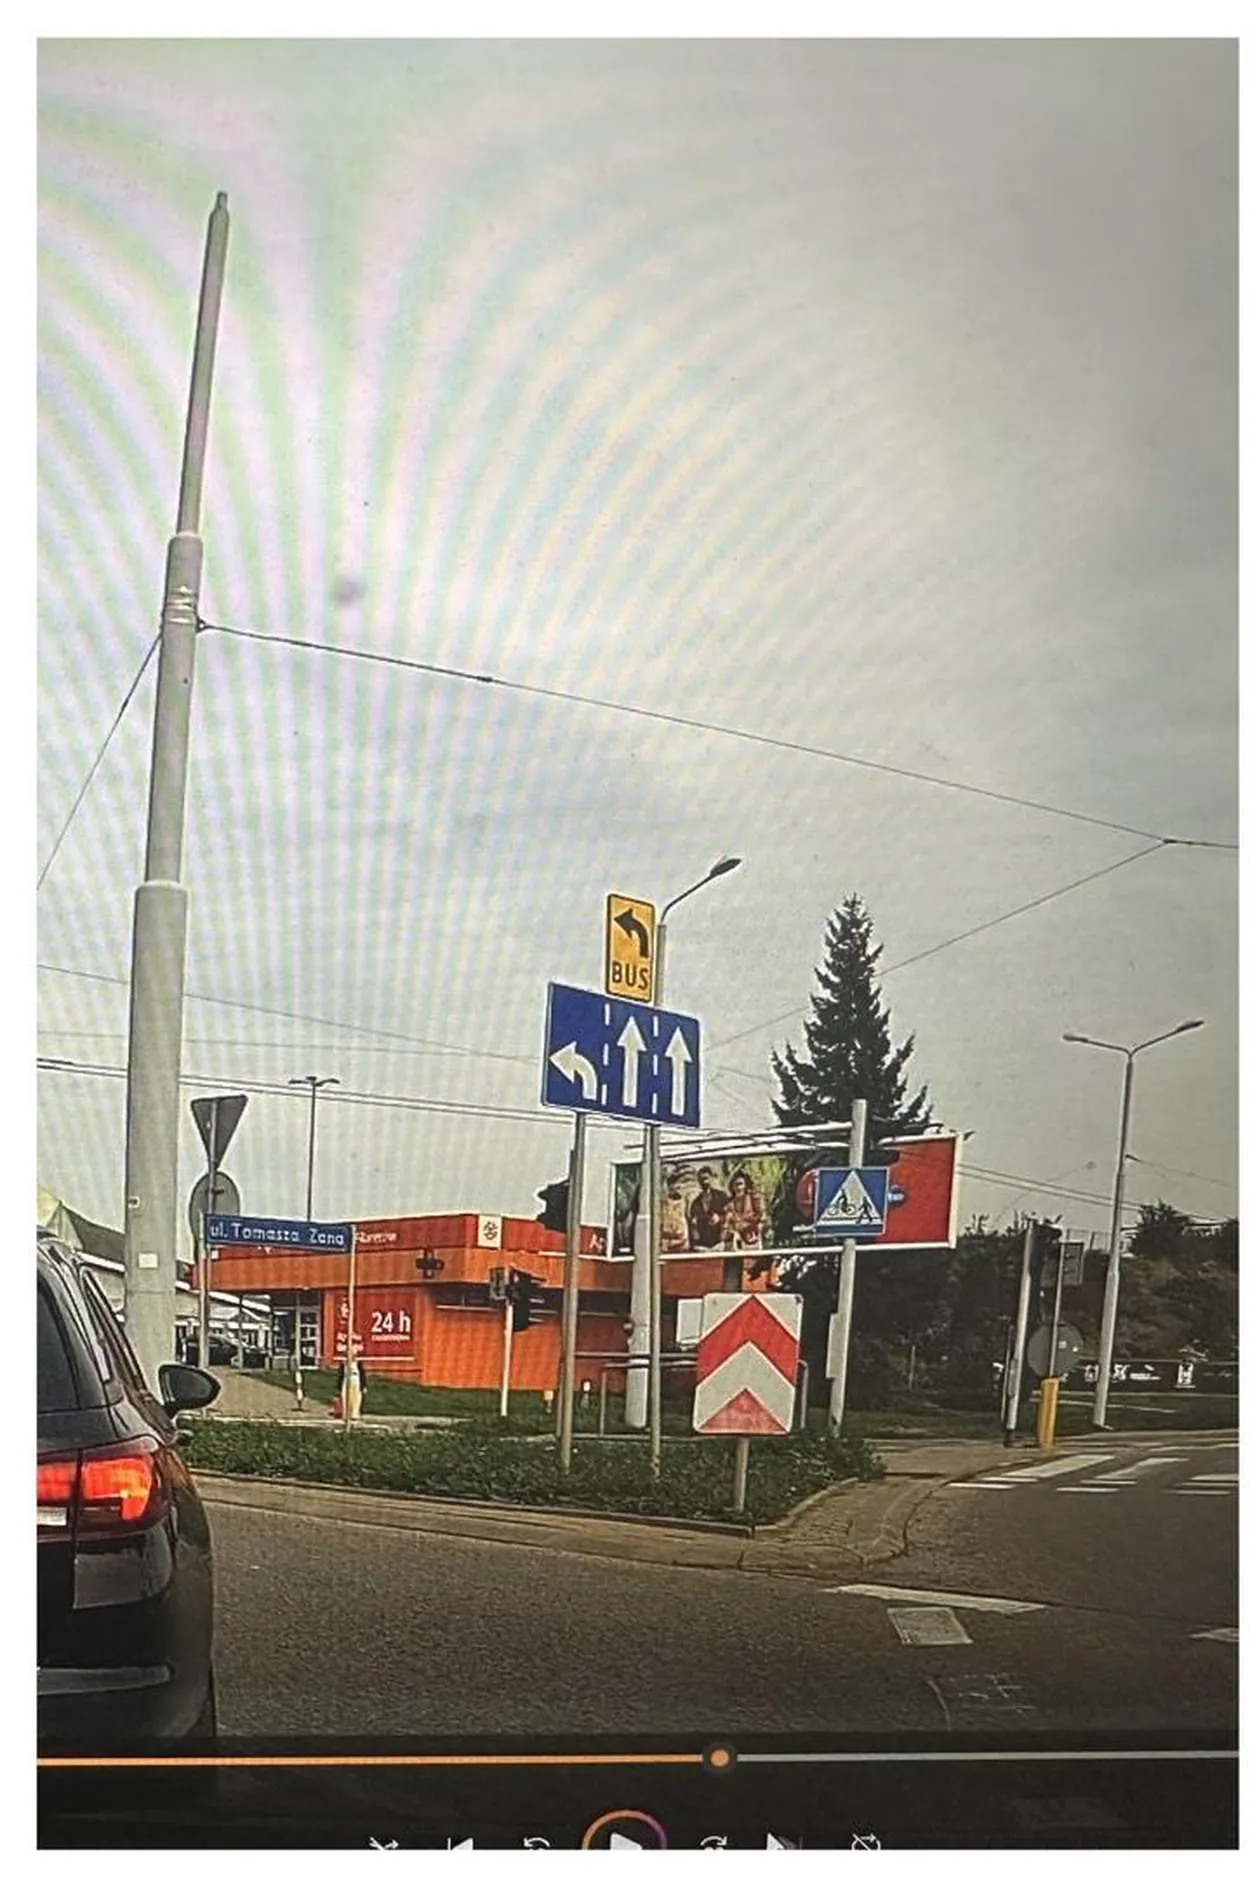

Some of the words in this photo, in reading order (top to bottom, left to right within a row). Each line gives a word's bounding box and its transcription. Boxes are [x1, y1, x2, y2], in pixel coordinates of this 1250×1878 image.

[612, 961, 649, 990] BUS
[209, 1222, 228, 1238] ul.
[232, 1223, 299, 1243] Tomasza
[309, 1228, 345, 1246] Zana
[371, 1310, 394, 1333] 24
[399, 1309, 411, 1333] h
